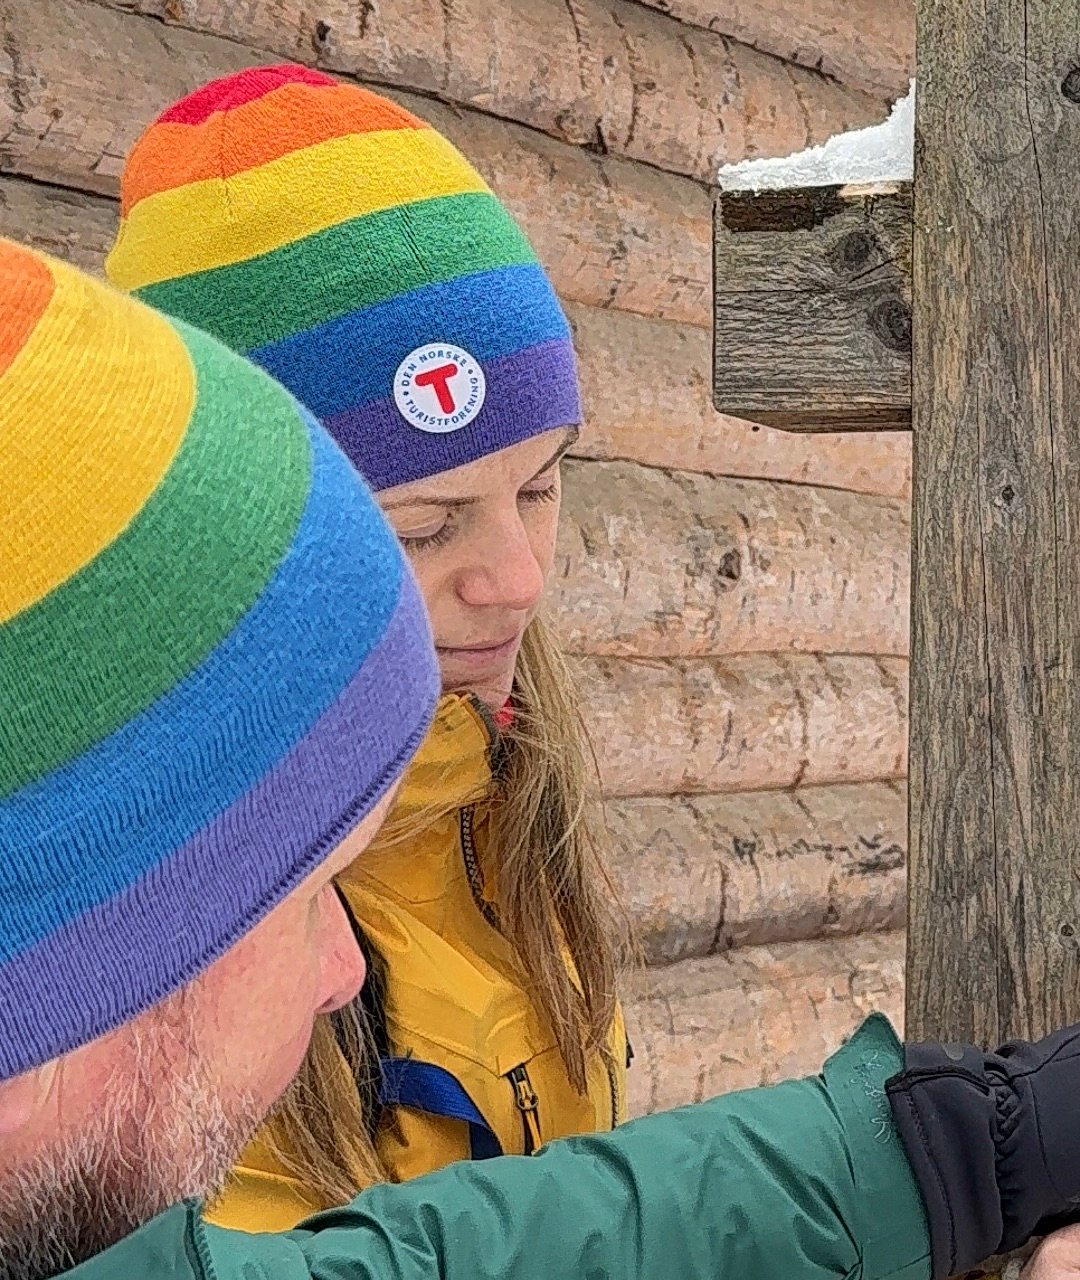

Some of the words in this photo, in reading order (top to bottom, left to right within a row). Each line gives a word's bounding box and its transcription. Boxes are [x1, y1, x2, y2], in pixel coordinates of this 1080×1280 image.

[401, 363, 417, 387] DEN
[419, 350, 468, 368] NORSKE
[415, 363, 458, 414] T
[405, 377, 479, 426] TURISTFORENING
